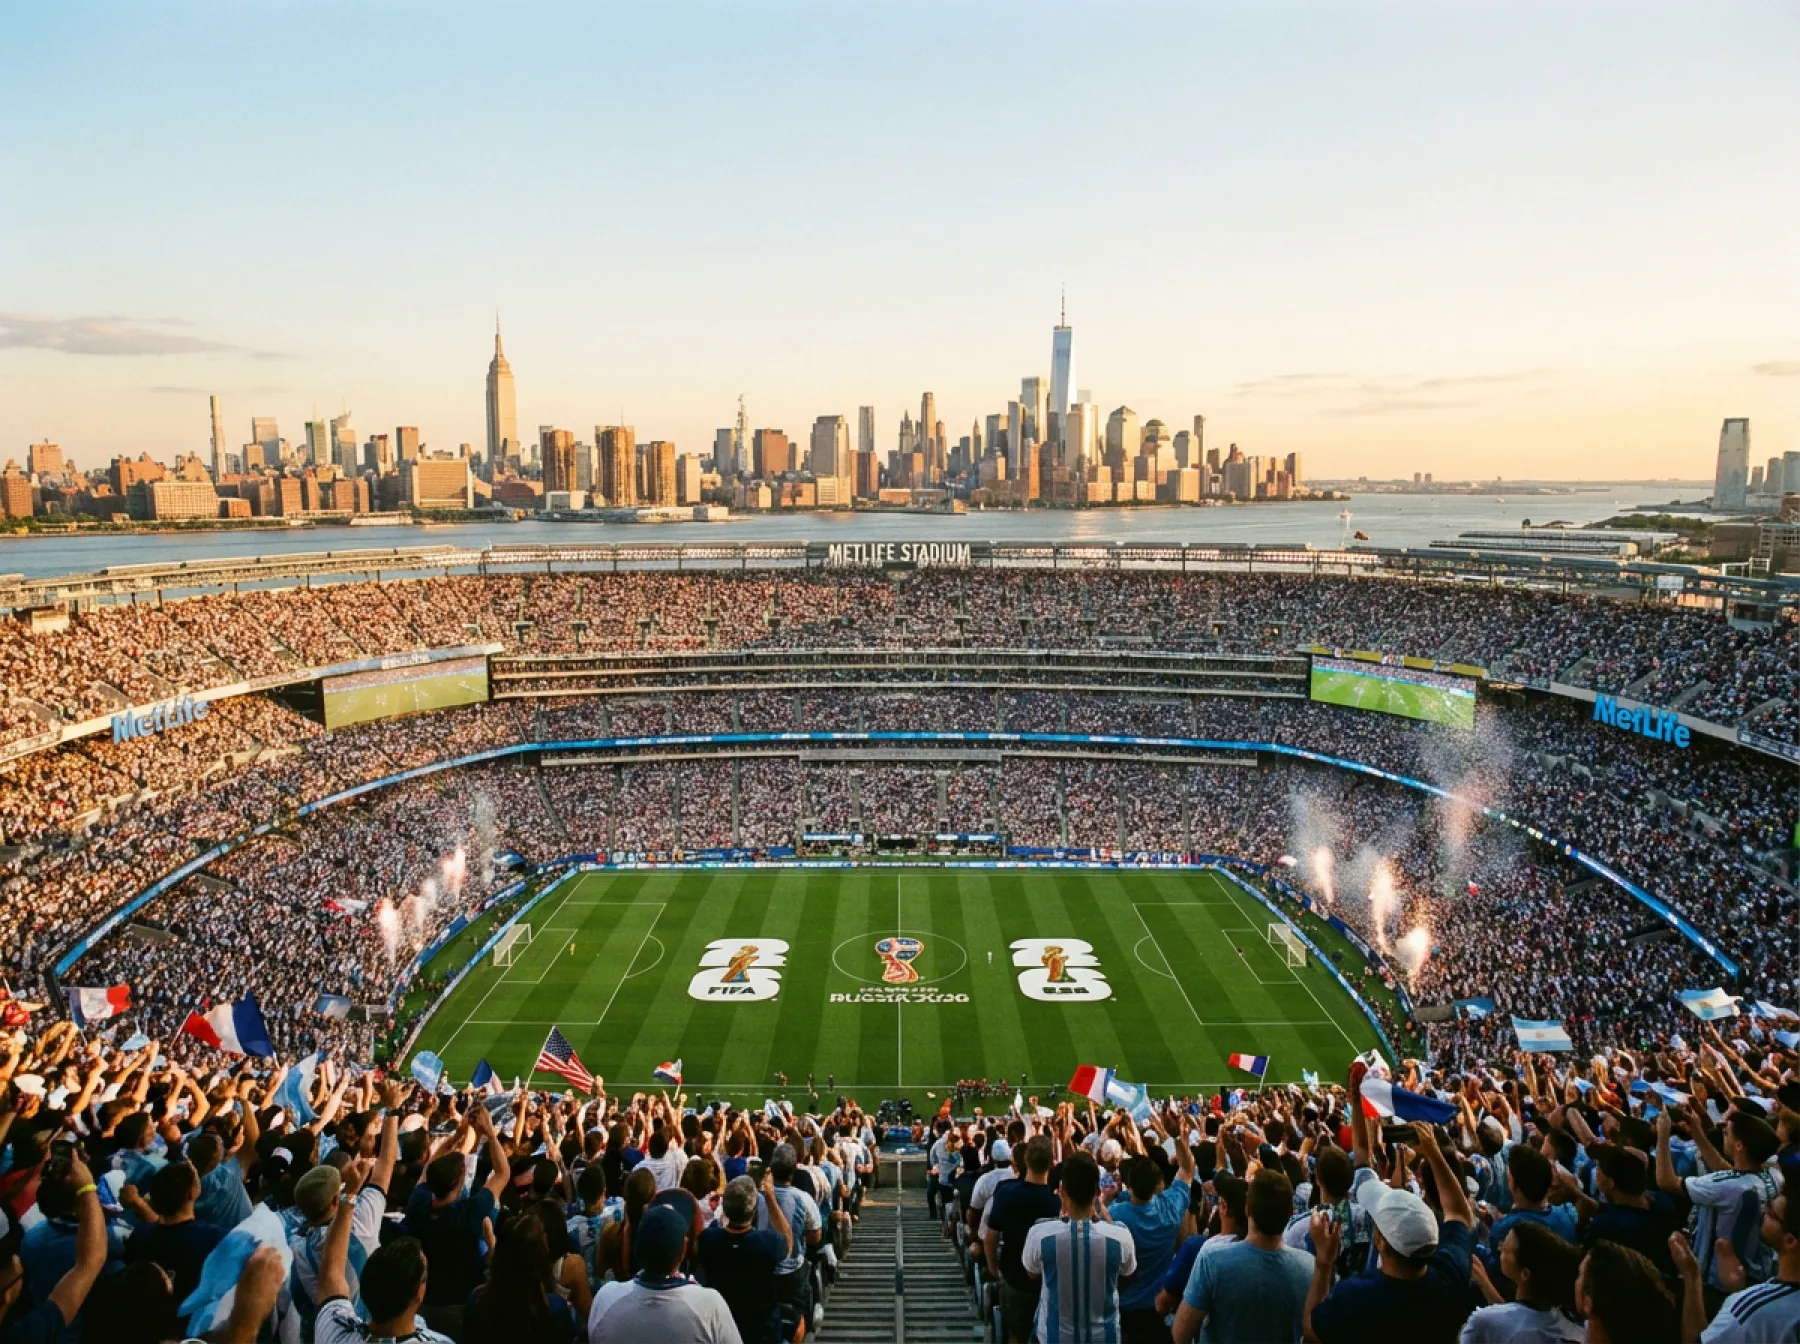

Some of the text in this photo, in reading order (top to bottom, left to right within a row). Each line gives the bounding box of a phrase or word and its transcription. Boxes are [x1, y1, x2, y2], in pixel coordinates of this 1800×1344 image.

[828, 542, 971, 564] METLIFE STADIUM
[1593, 692, 1690, 748] MetLife
[708, 986, 756, 995] FIFA
